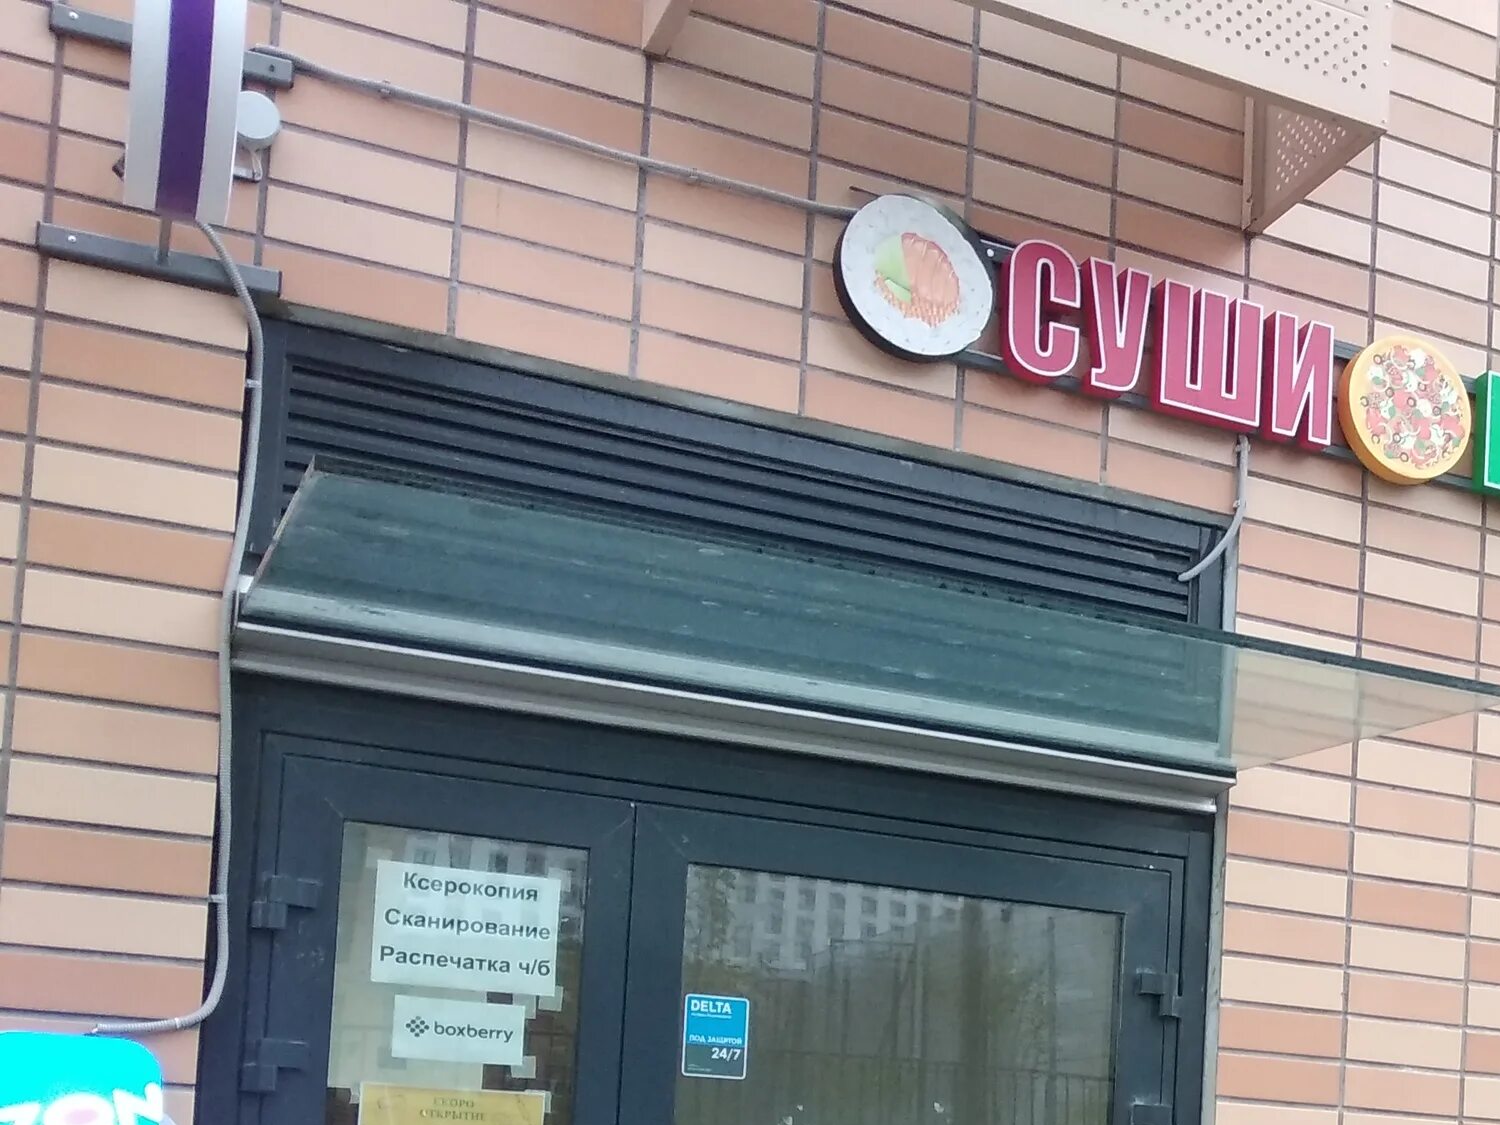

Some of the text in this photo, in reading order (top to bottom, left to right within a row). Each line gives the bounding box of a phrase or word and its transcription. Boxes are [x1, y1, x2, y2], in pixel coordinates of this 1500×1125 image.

[1004, 239, 1335, 448] СУШИ
[403, 871, 538, 902] Ксерокопия
[384, 908, 551, 940] Сканирование
[379, 945, 551, 976] Распечатка ч/б
[690, 999, 732, 1015] DELTA
[434, 1021, 514, 1043] boxberry
[711, 1047, 741, 1062] 24/7
